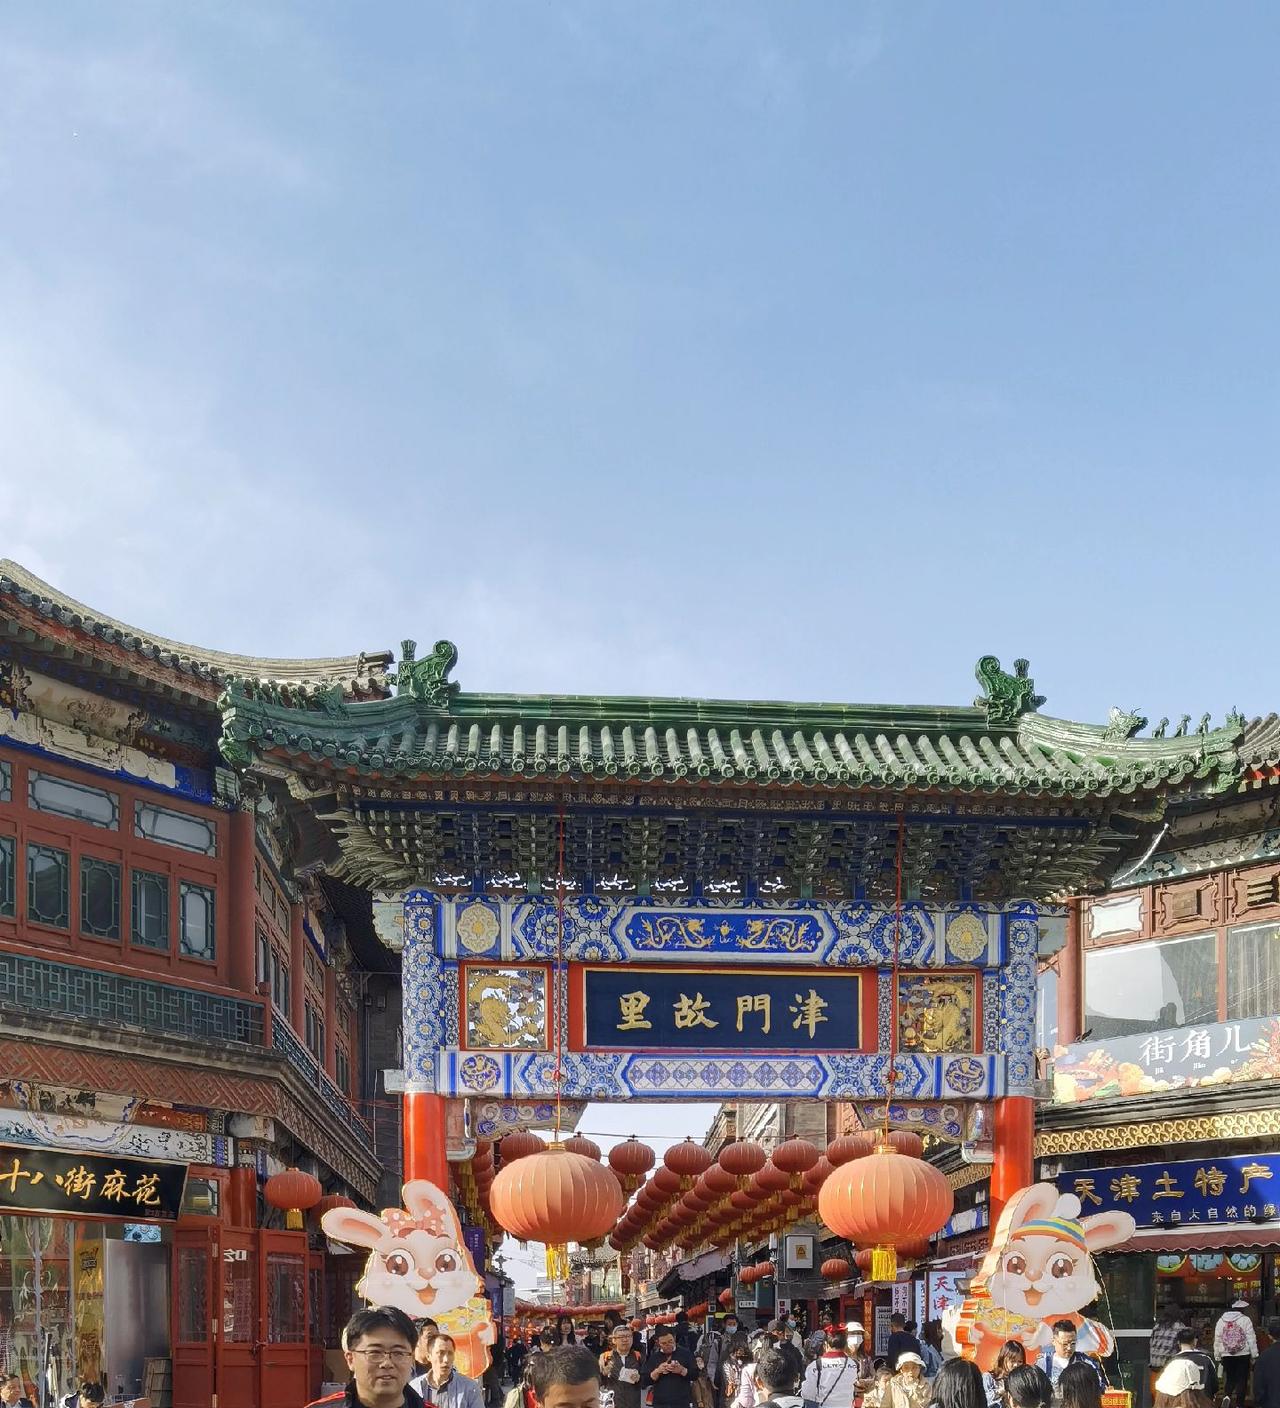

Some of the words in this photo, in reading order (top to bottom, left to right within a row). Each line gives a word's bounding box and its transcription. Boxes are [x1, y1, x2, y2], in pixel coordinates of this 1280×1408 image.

[616, 989, 828, 1039] 津門故里
[1138, 1024, 1251, 1067] 街角儿
[0, 1158, 161, 1206] 十八街麻花
[1073, 1162, 1274, 1206] 天津土特产
